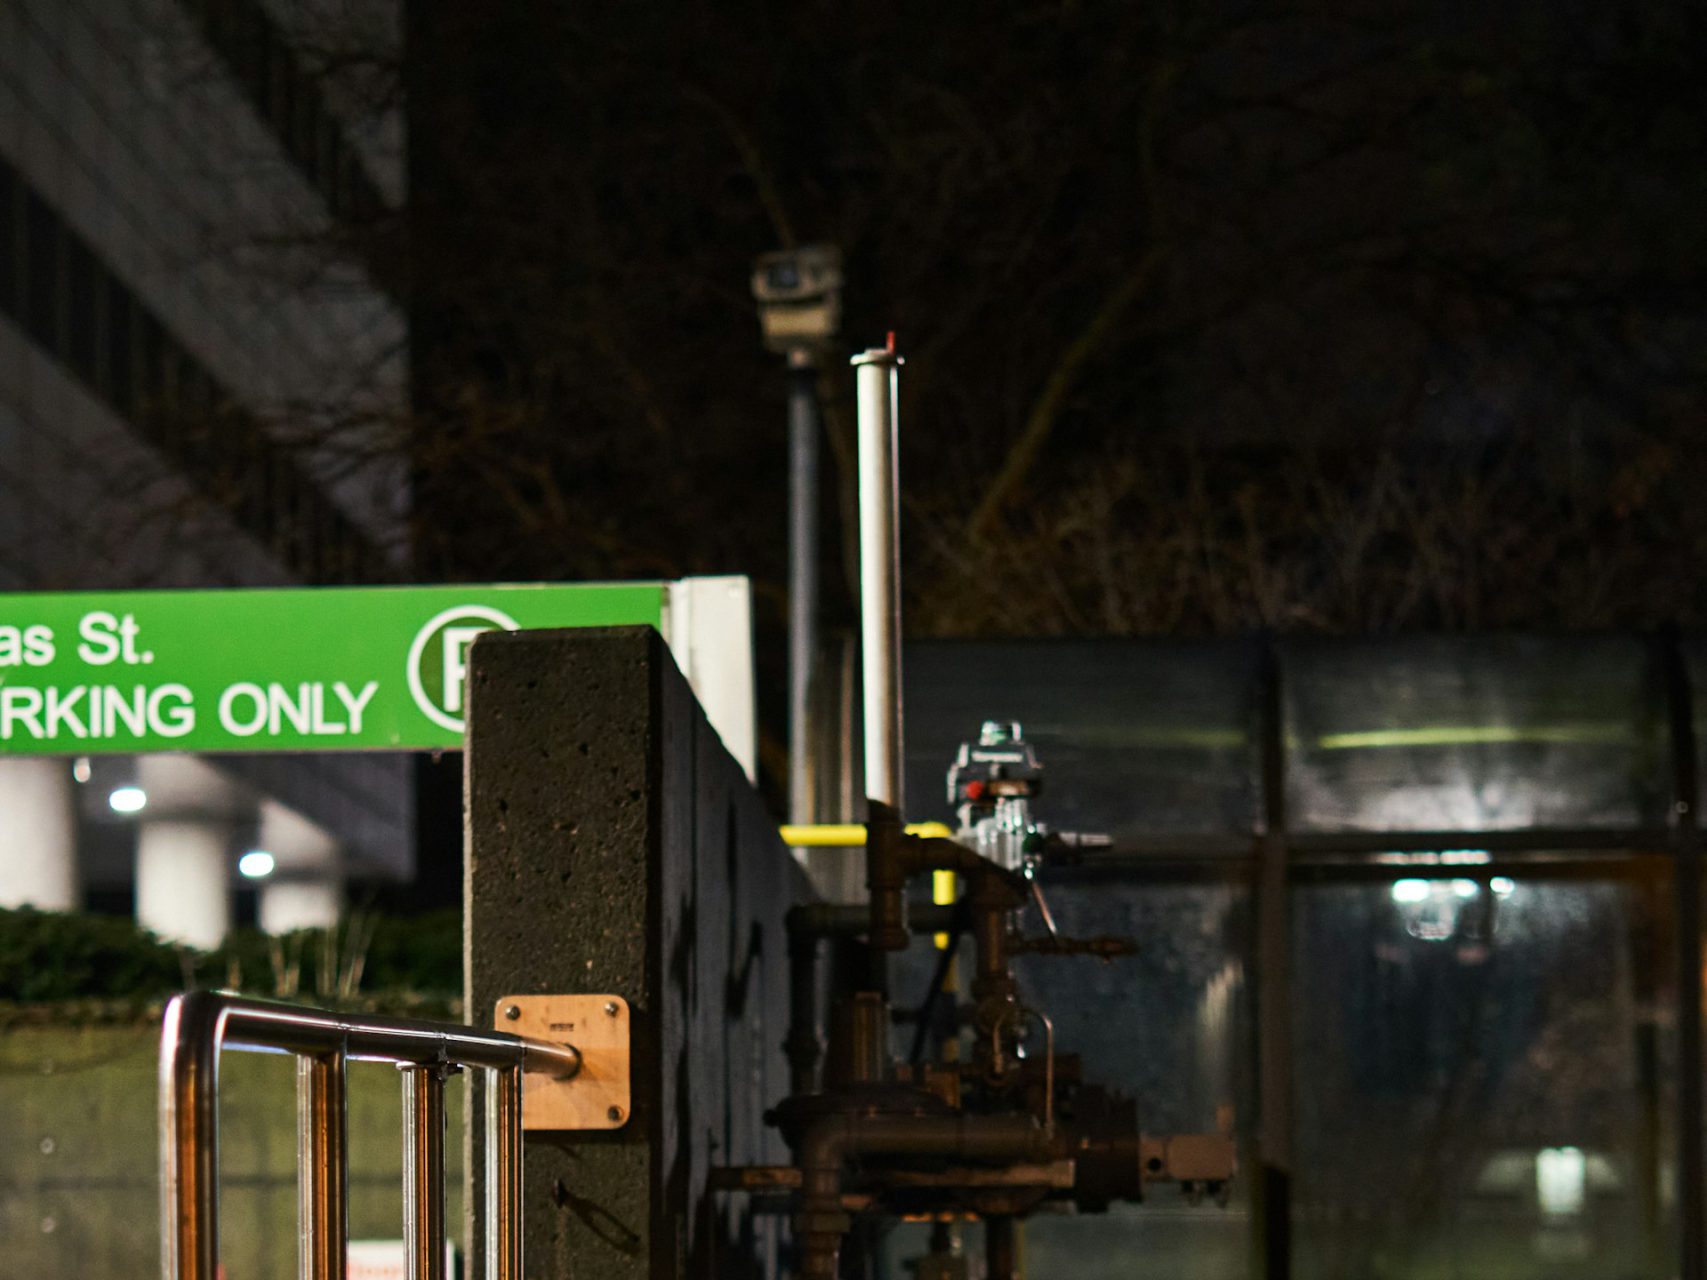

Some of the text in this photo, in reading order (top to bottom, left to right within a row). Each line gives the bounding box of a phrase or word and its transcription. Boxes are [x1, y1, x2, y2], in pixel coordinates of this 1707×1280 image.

[0, 611, 154, 666] as St.
[1, 682, 378, 738] RKING ONLY
